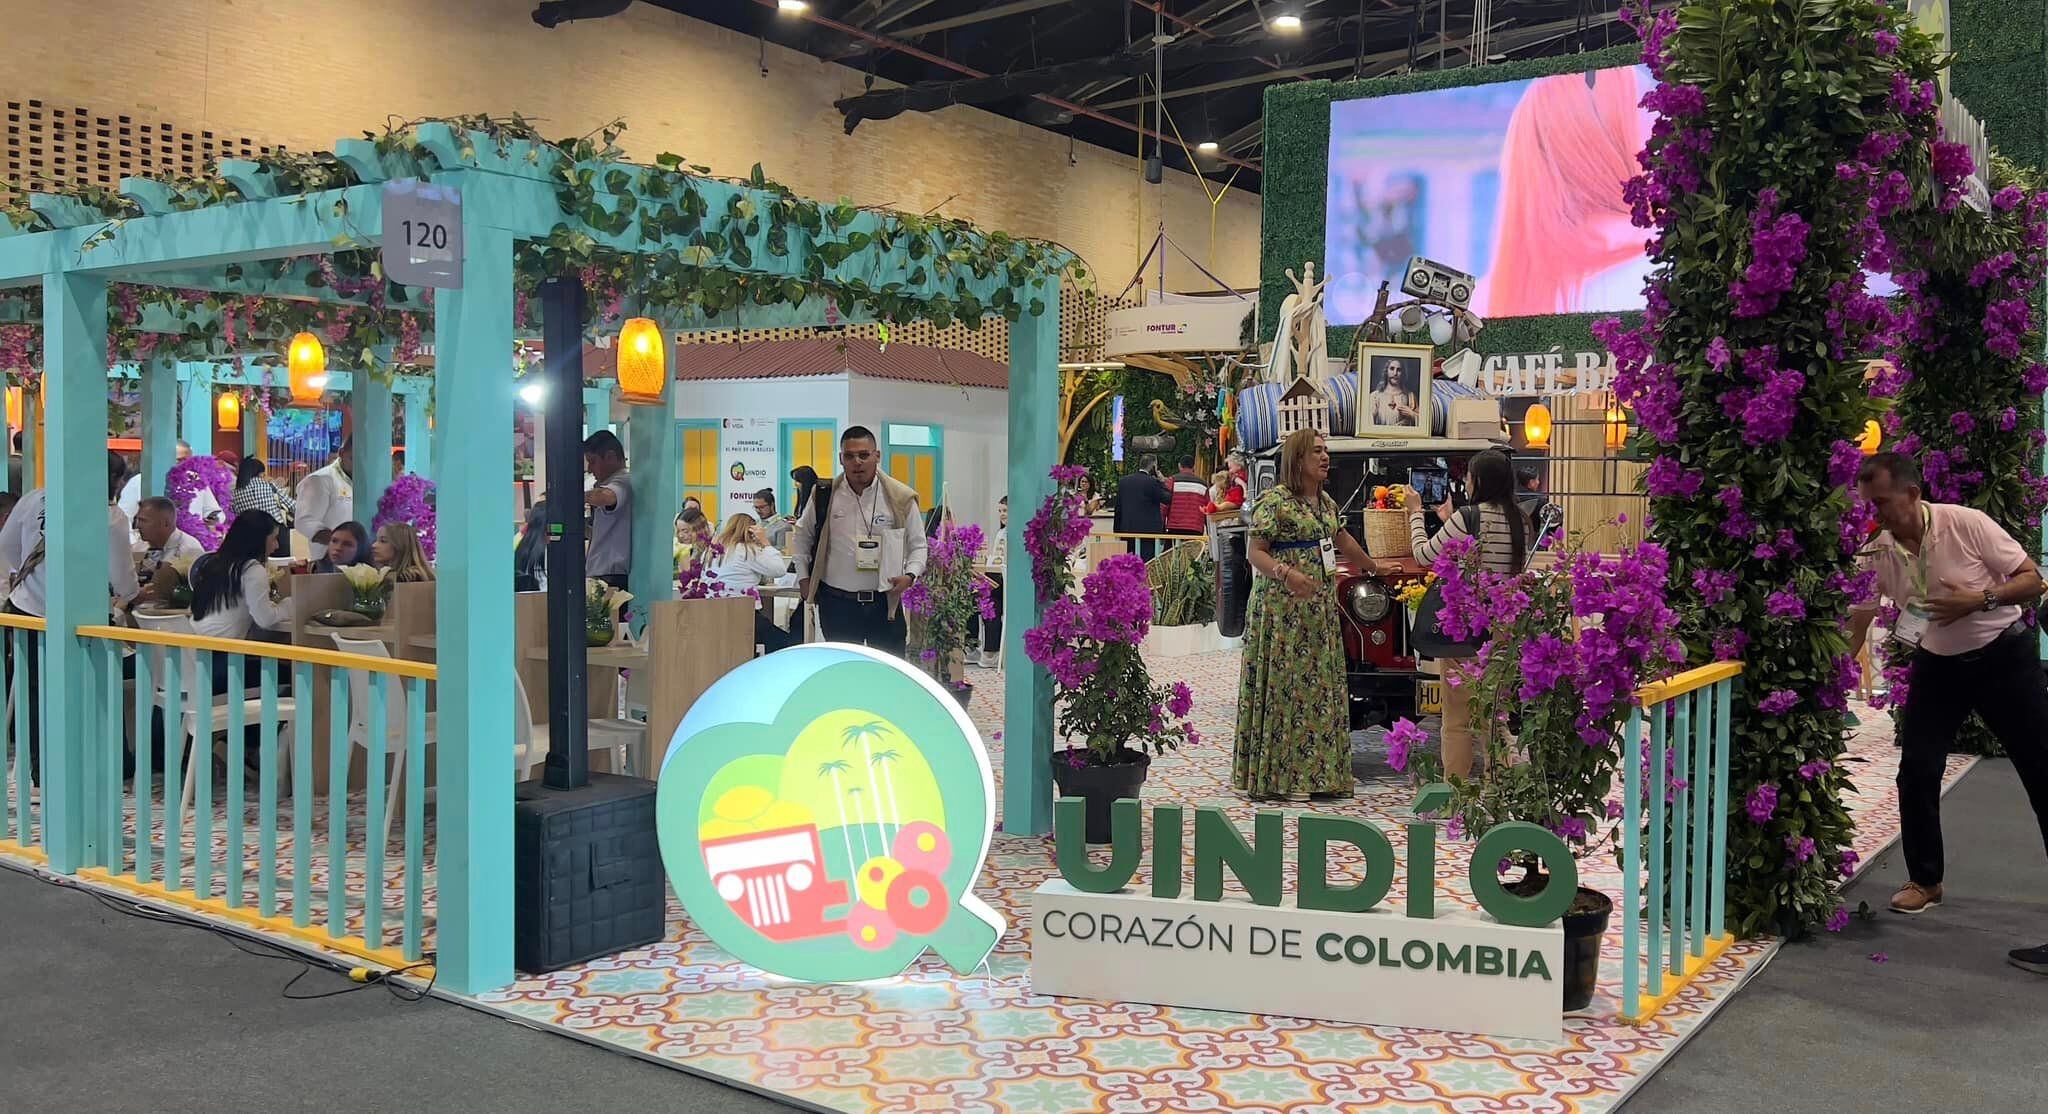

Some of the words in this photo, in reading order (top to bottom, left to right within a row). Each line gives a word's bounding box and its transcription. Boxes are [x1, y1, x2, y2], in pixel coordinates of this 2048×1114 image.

[402, 220, 447, 249] 120
[1146, 323, 1176, 333] FONTUR
[1485, 345, 1563, 396] CAFÉ
[730, 492, 757, 500] FONTU
[1420, 687, 1443, 705] HU
[1043, 910, 1233, 953] CORAZÓN
[1249, 926, 1302, 958] DE
[1315, 932, 1553, 981] COLOMBIA
